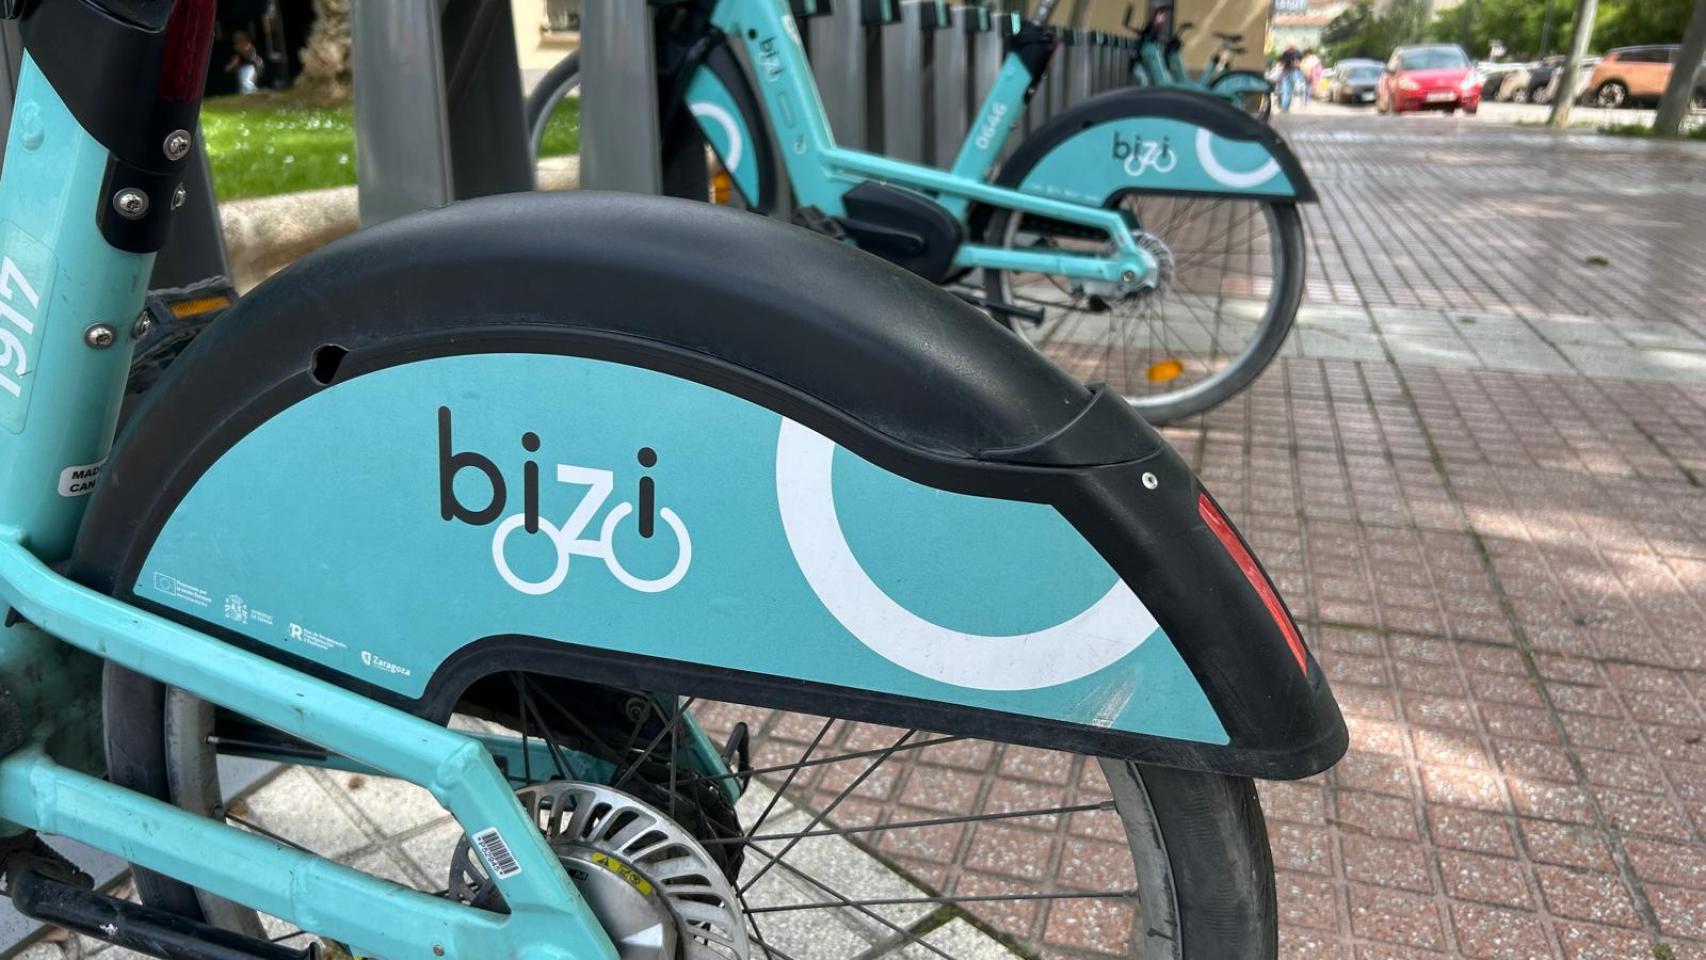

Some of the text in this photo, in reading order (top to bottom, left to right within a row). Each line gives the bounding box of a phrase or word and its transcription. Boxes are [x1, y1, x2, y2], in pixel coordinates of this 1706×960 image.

[1112, 131, 1172, 166] bizi
[72, 466, 100, 480] MAD
[438, 405, 660, 562] bizi
[70, 480, 96, 493] CAN
[373, 654, 411, 676] Zaragoza
